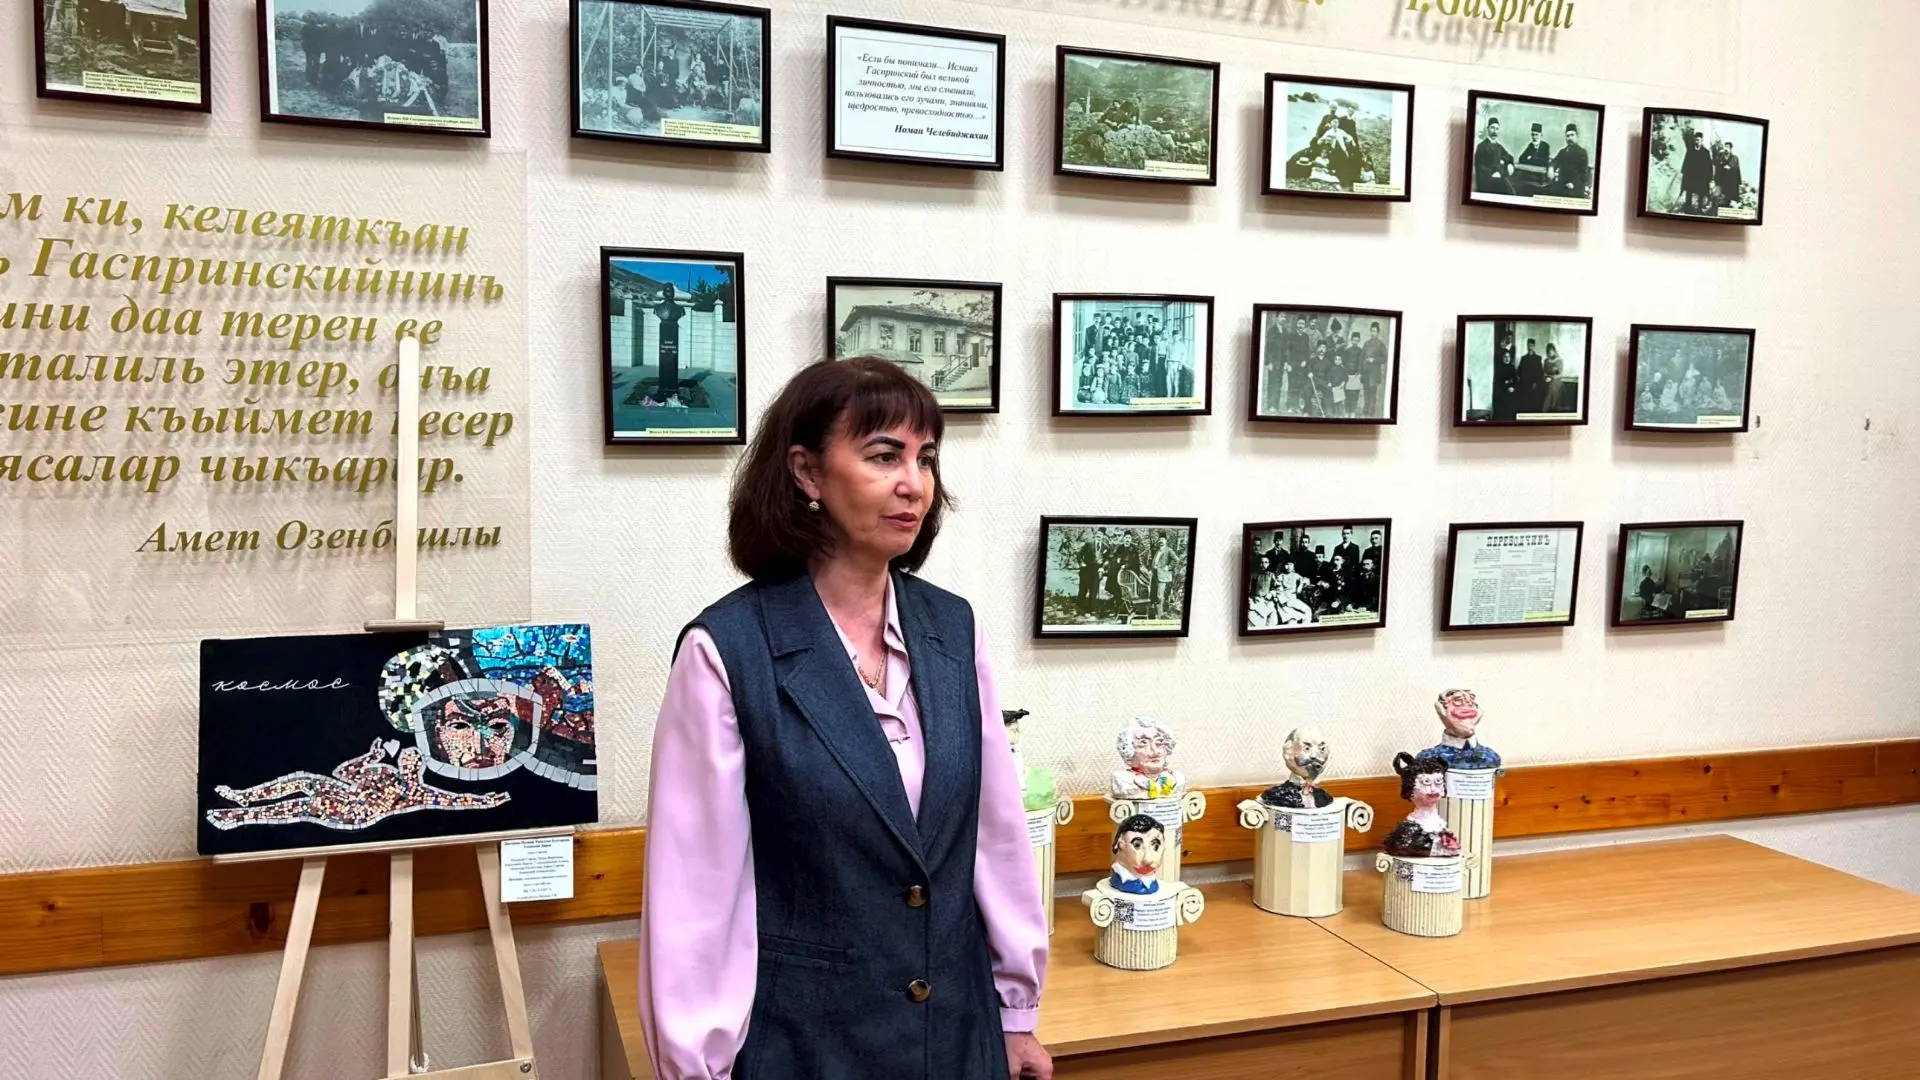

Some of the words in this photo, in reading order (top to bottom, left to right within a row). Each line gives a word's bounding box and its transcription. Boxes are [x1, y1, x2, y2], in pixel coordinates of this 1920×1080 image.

[866, 65, 919, 79] Гаспринский
[920, 70, 937, 81] был
[938, 74, 970, 84] великой
[884, 55, 896, 65] бы
[844, 90, 899, 101] пользовались
[847, 101, 899, 113] щедростью,
[894, 124, 924, 135] Номан
[926, 126, 989, 140] Челебиджихан
[62, 196, 143, 236] ки,
[163, 202, 470, 255] келеяткъан
[28, 237, 505, 301] Гаспринскийнинъ
[110, 294, 202, 335] даа
[220, 308, 378, 350] терен
[222, 357, 360, 397] этер,
[0, 403, 107, 432] ине
[125, 397, 374, 436] къыймет
[391, 410, 513, 447] есер
[0, 454, 180, 493] ясалар
[137, 521, 260, 553] Амет
[276, 518, 502, 551] Озенбшлы
